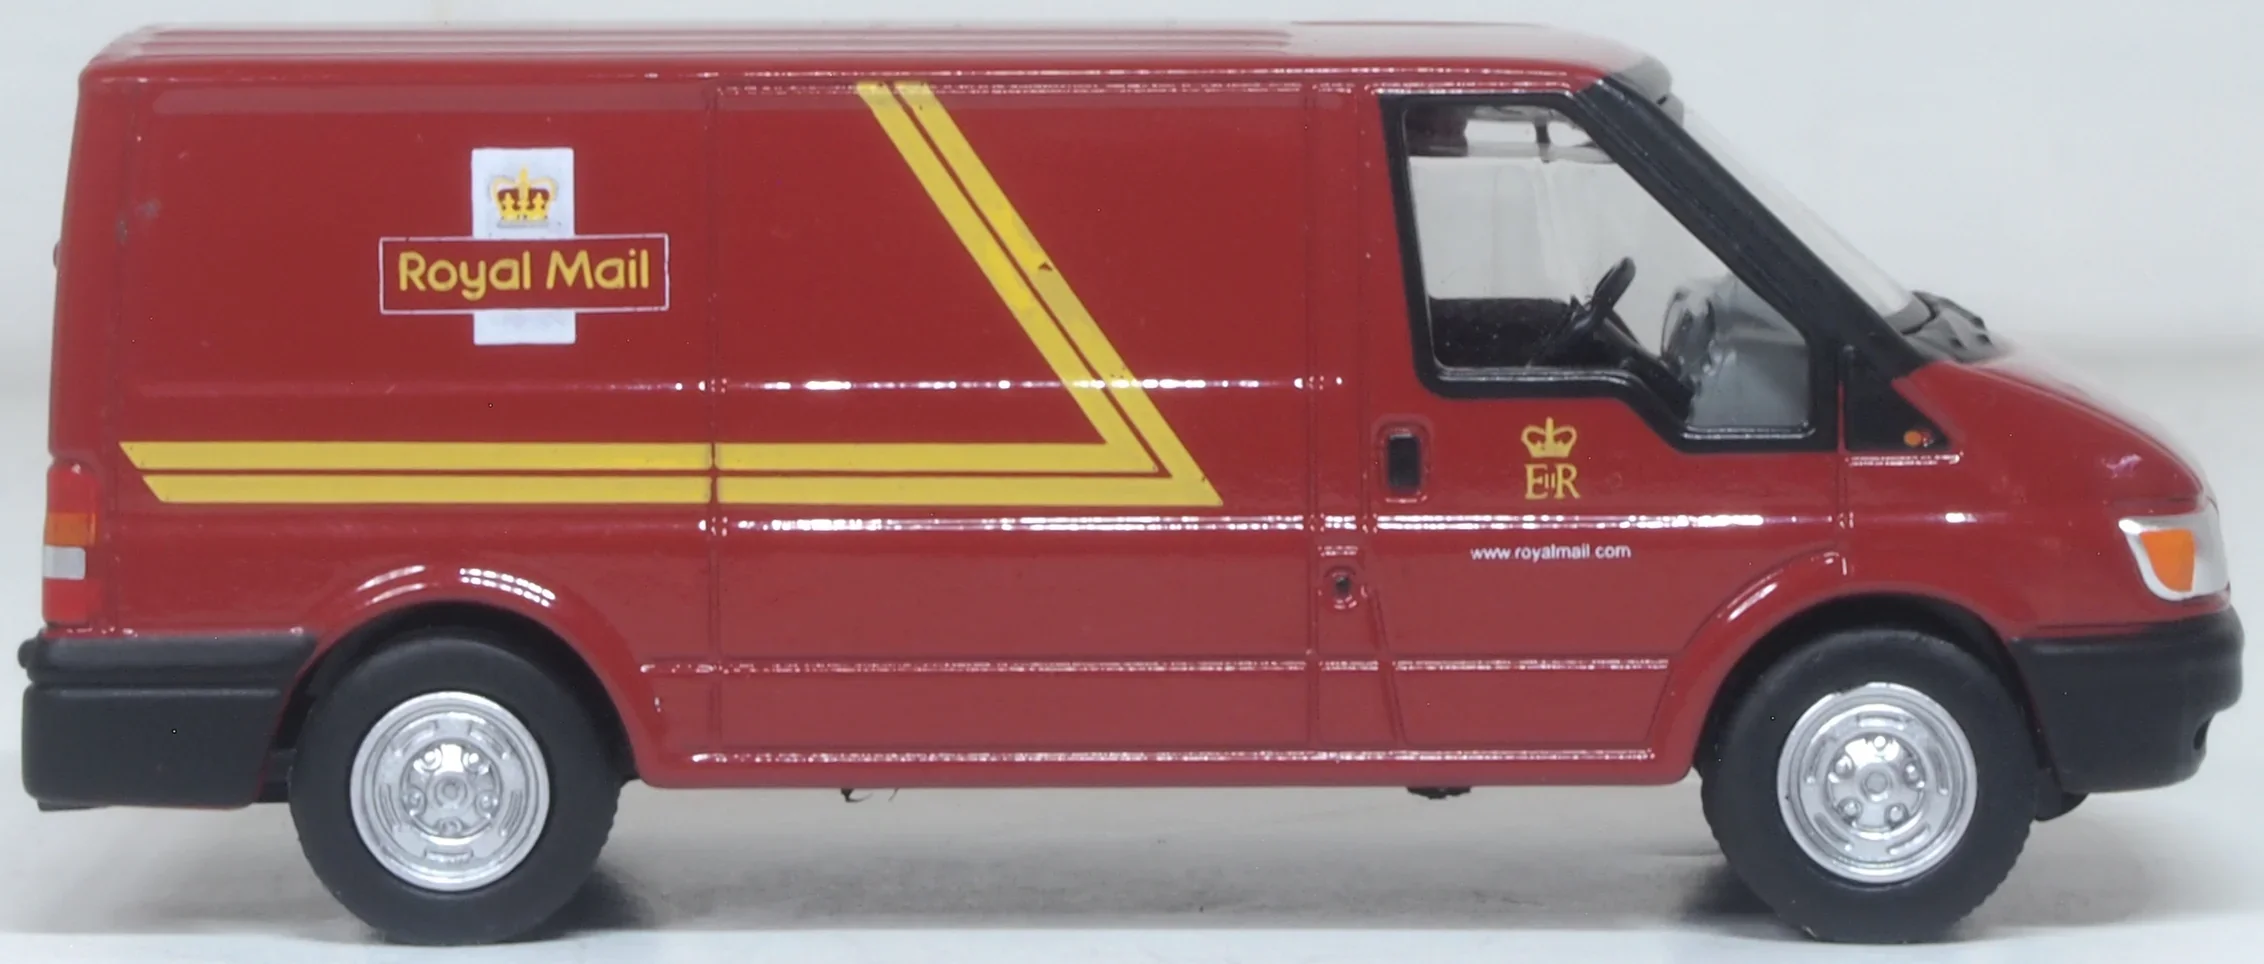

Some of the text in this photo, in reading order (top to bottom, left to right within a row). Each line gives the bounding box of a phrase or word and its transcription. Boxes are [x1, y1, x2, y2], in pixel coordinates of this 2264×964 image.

[398, 248, 649, 301] Royal Mail
[1470, 542, 1632, 563] www.royalmail.com
